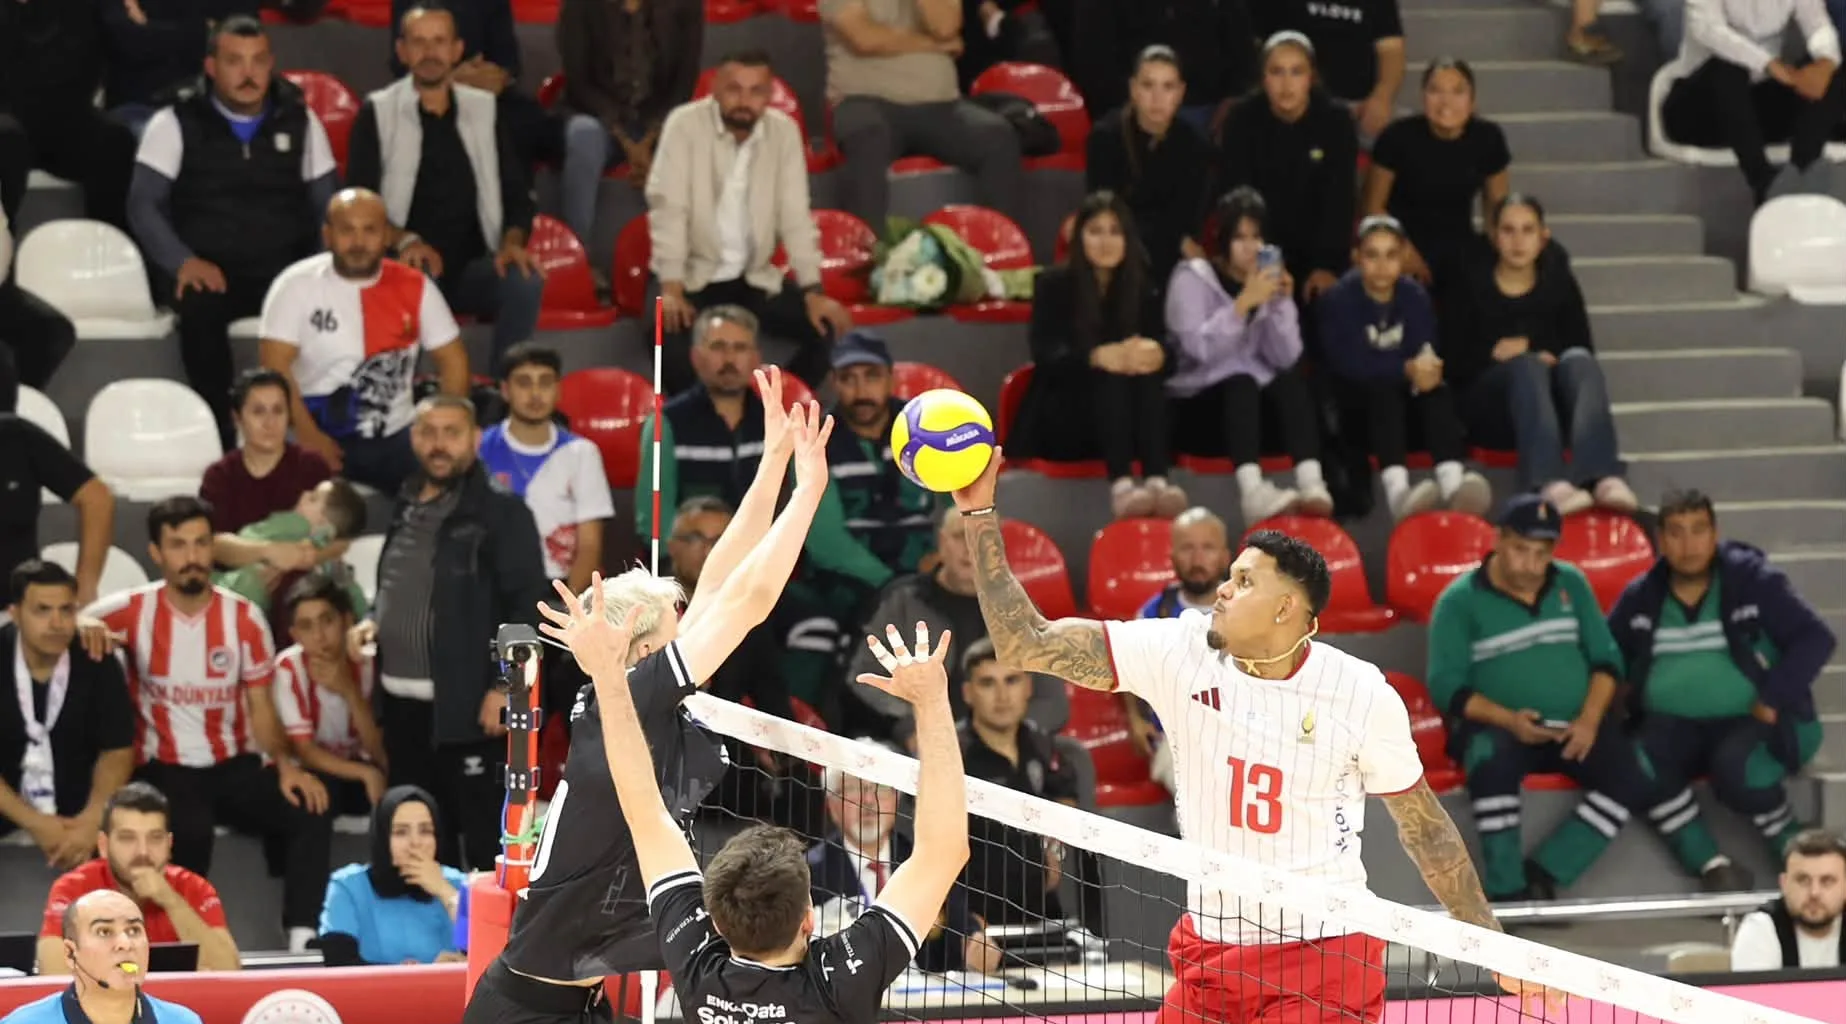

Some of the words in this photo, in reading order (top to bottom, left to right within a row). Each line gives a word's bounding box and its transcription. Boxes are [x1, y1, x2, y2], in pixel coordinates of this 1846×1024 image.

[310, 309, 338, 333] 46
[1226, 755, 1283, 834] 13
[741, 1003, 786, 1019] Data
